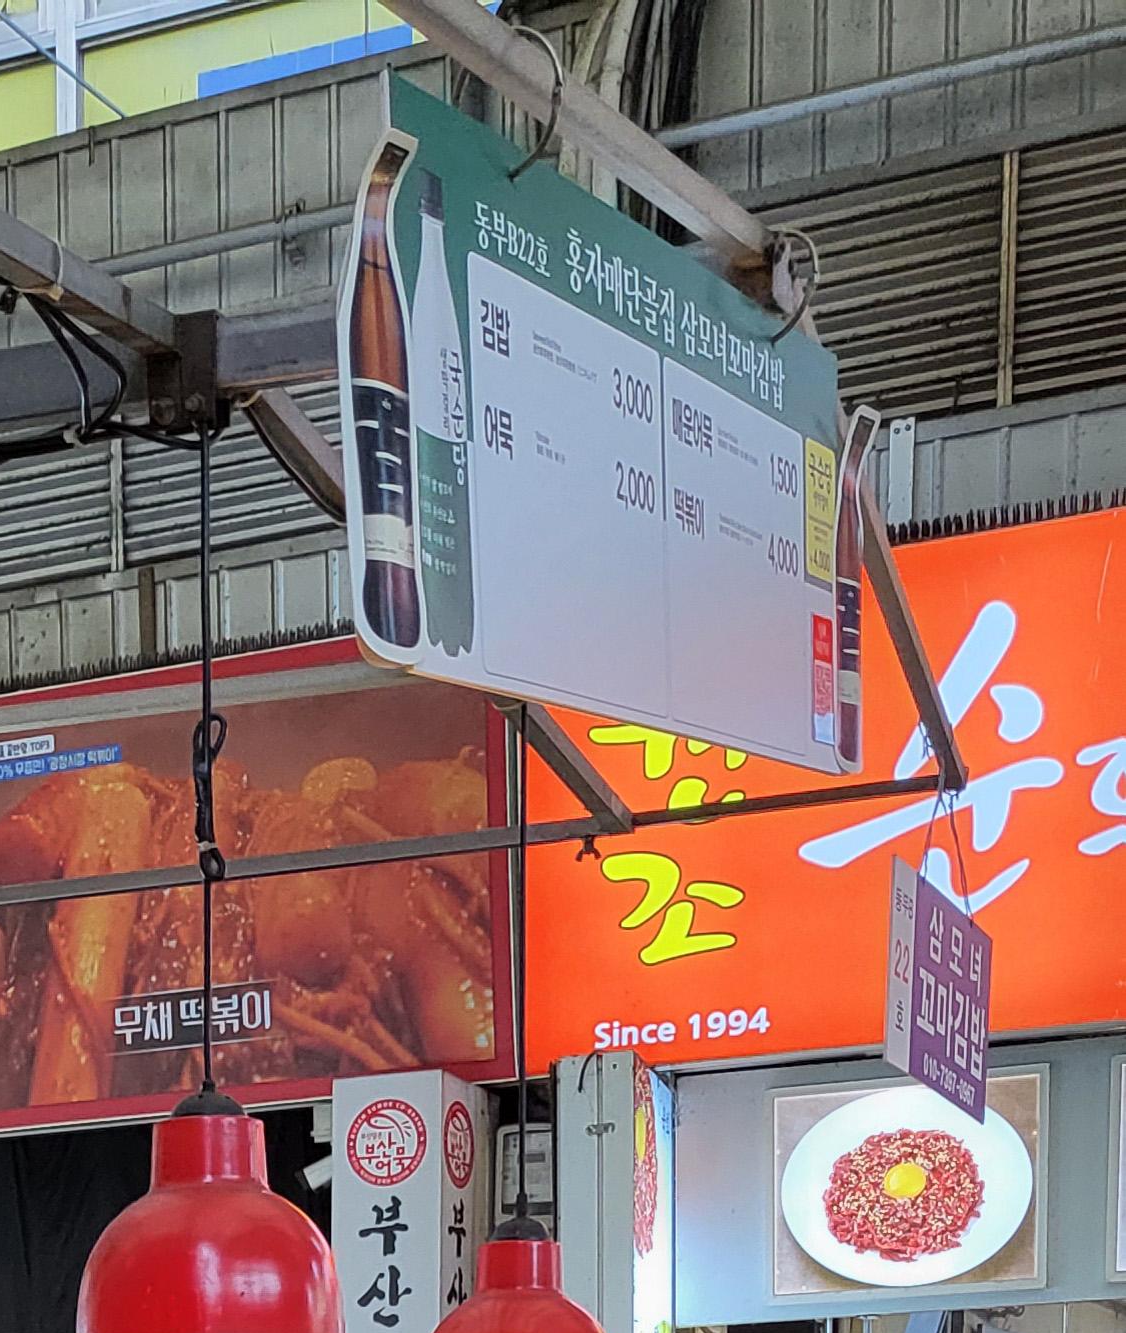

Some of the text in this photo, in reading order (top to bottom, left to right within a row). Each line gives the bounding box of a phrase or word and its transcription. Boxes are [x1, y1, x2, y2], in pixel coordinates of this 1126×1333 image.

[474, 201, 551, 278] 동부B22호
[564, 226, 675, 348] 홍자매단골집
[480, 299, 511, 358] 김밥
[613, 367, 653, 424] 3,000
[484, 404, 514, 461] 어묵
[615, 461, 655, 514] 2,000
[770, 452, 798, 498] 1,500
[674, 487, 705, 541] 떡볶이
[768, 532, 799, 577] 4,000
[893, 938, 910, 985] 22
[113, 990, 272, 1046] 무채 떡볶이
[594, 1007, 771, 1051] Since 1994
[916, 965, 987, 1082] 꼬마김밥
